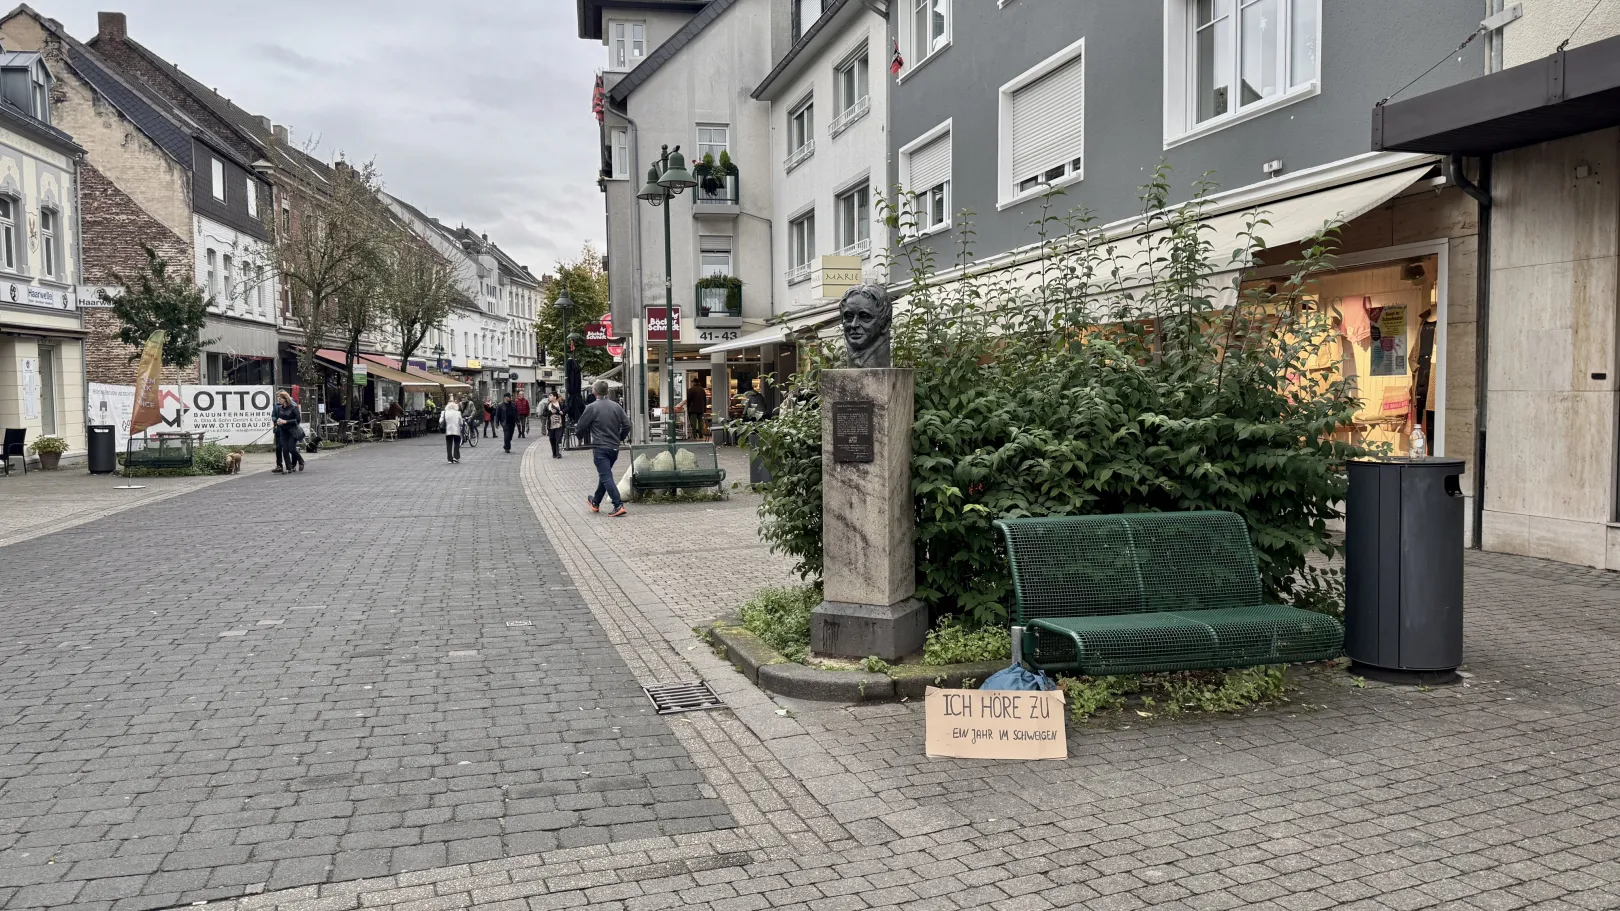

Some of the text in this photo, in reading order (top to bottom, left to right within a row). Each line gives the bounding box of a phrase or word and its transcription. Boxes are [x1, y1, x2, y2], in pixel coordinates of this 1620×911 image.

[826, 273, 859, 281] MARIE
[193, 390, 271, 411] OTTO
[943, 692, 1050, 719] ICH HÖRE ZU
[952, 727, 1058, 744] EIN JAHR IM SCHWEIGEN
